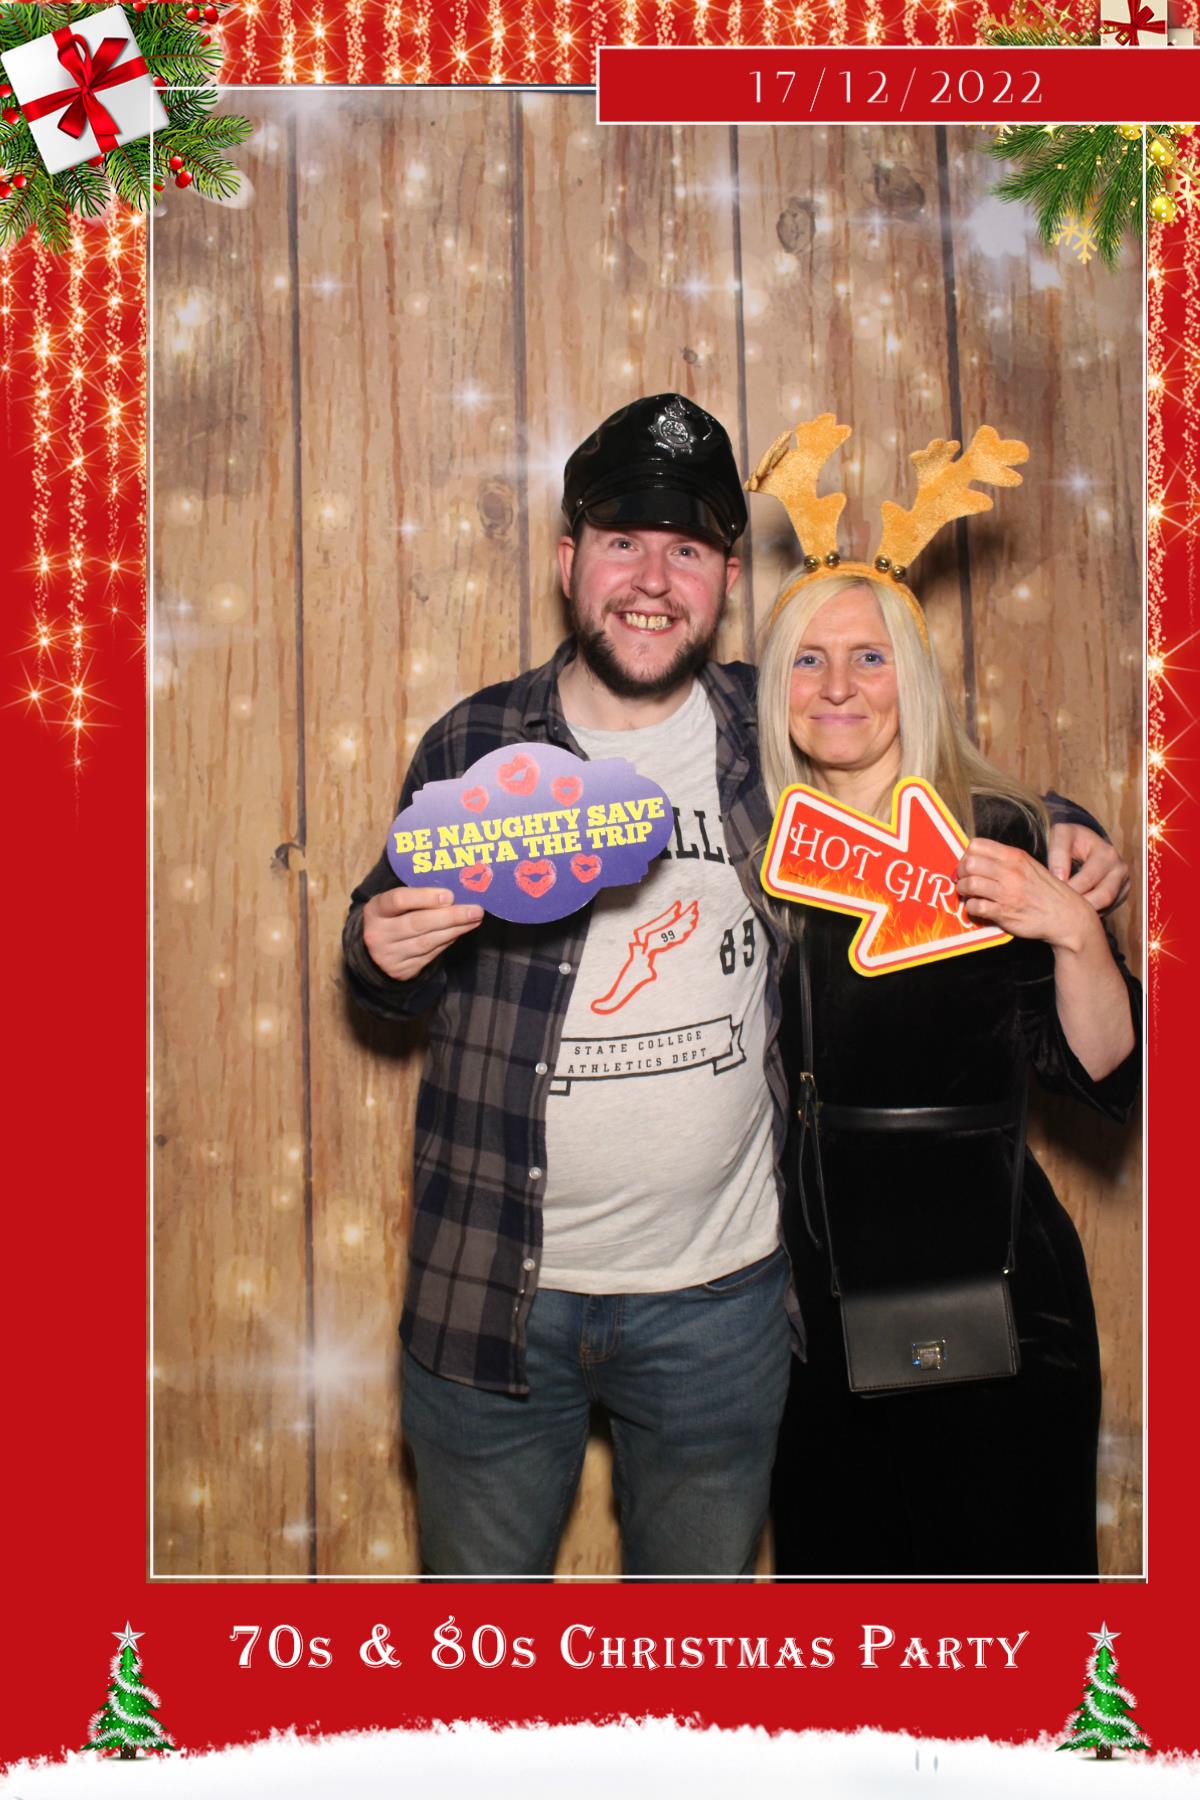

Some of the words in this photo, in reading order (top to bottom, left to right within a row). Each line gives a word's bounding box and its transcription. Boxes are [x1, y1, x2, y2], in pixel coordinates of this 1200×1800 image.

[394, 829, 433, 853] BE
[438, 808, 581, 847] NAUGHTY
[587, 797, 665, 826] SAVE
[412, 844, 518, 874] SANTA
[522, 831, 582, 858] THE
[587, 822, 653, 849] TRIP
[789, 821, 883, 881] HOT
[660, 930, 676, 943] 99
[574, 1043, 629, 1056] STATE
[638, 1030, 703, 1051] COLLEGE
[567, 1057, 663, 1075] ATHLETICS
